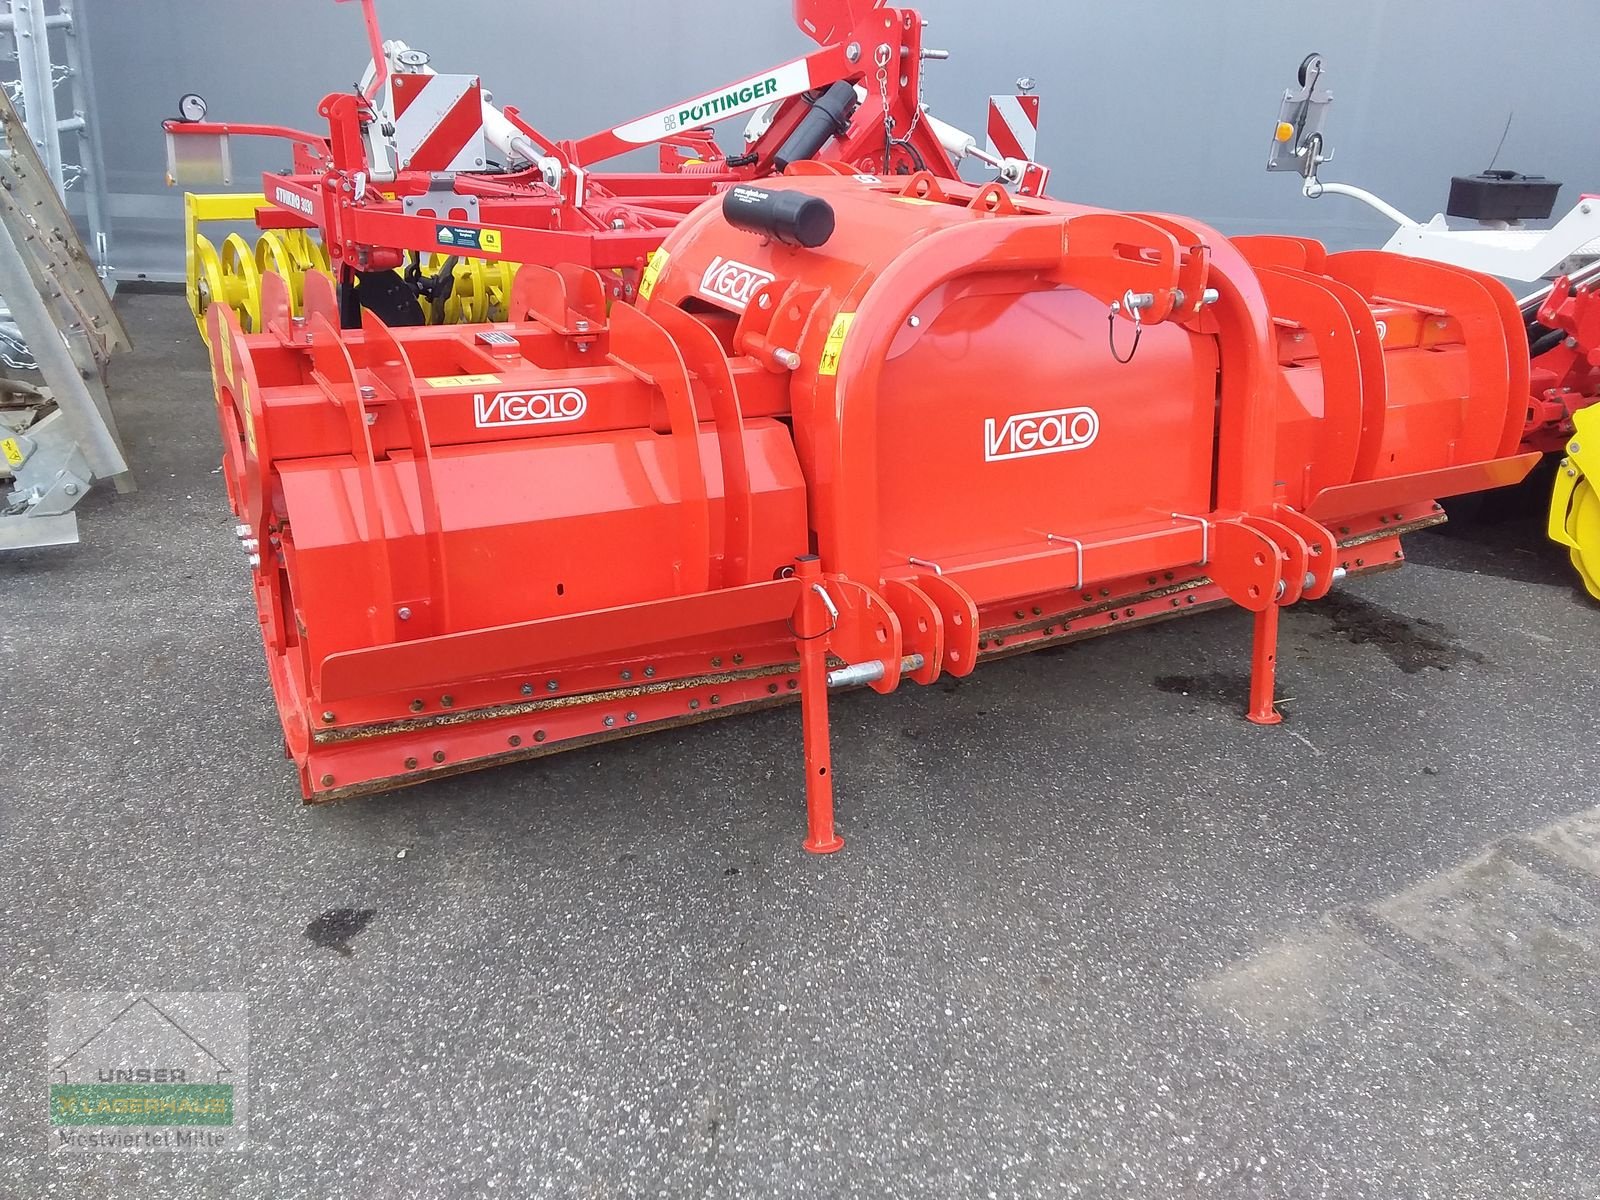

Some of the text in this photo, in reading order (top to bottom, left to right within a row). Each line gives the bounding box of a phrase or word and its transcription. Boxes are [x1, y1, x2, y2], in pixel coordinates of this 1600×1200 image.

[679, 78, 777, 126] PÖTTINGER
[474, 387, 587, 428] VIGOLO
[984, 406, 1099, 462] VIGOLO
